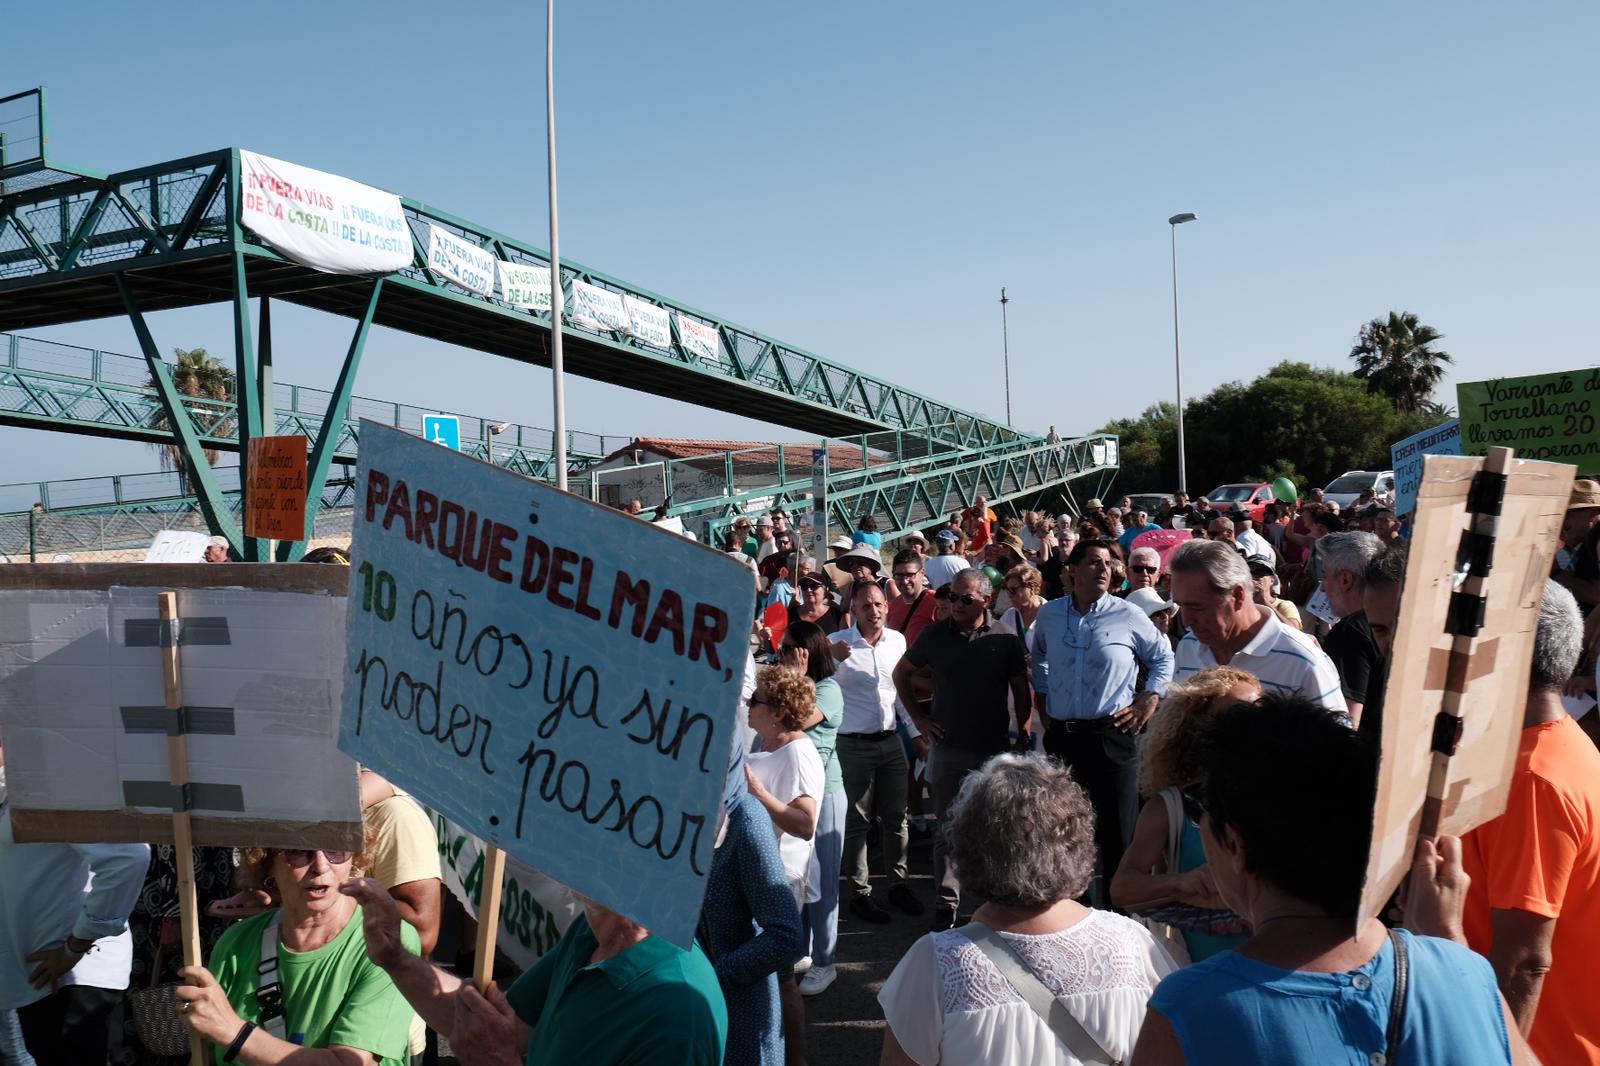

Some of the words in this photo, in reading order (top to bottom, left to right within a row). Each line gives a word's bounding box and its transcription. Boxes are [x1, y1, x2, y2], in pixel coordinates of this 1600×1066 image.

[247, 192, 263, 212] DE
[267, 200, 283, 220] LA
[288, 208, 328, 234] COSTA
[342, 223, 356, 242] DE
[359, 228, 372, 247] LA
[434, 249, 447, 268] DE
[462, 268, 488, 292] COSTA
[508, 288, 520, 303] DE
[522, 289, 533, 304] LA
[1485, 374, 1575, 402] Variante
[1468, 423, 1554, 444] llevamos
[1563, 414, 1595, 437] 20
[1479, 398, 1591, 422] Torrellano
[366, 469, 518, 584] PARQUE
[520, 535, 602, 621] DEL
[608, 570, 733, 683] MAR,
[358, 560, 397, 622] 10
[411, 588, 533, 689] años
[537, 648, 609, 739] ya
[620, 679, 714, 774] sin
[355, 649, 495, 775] poder
[517, 740, 706, 877] pasar
[502, 872, 562, 958] OSTA
